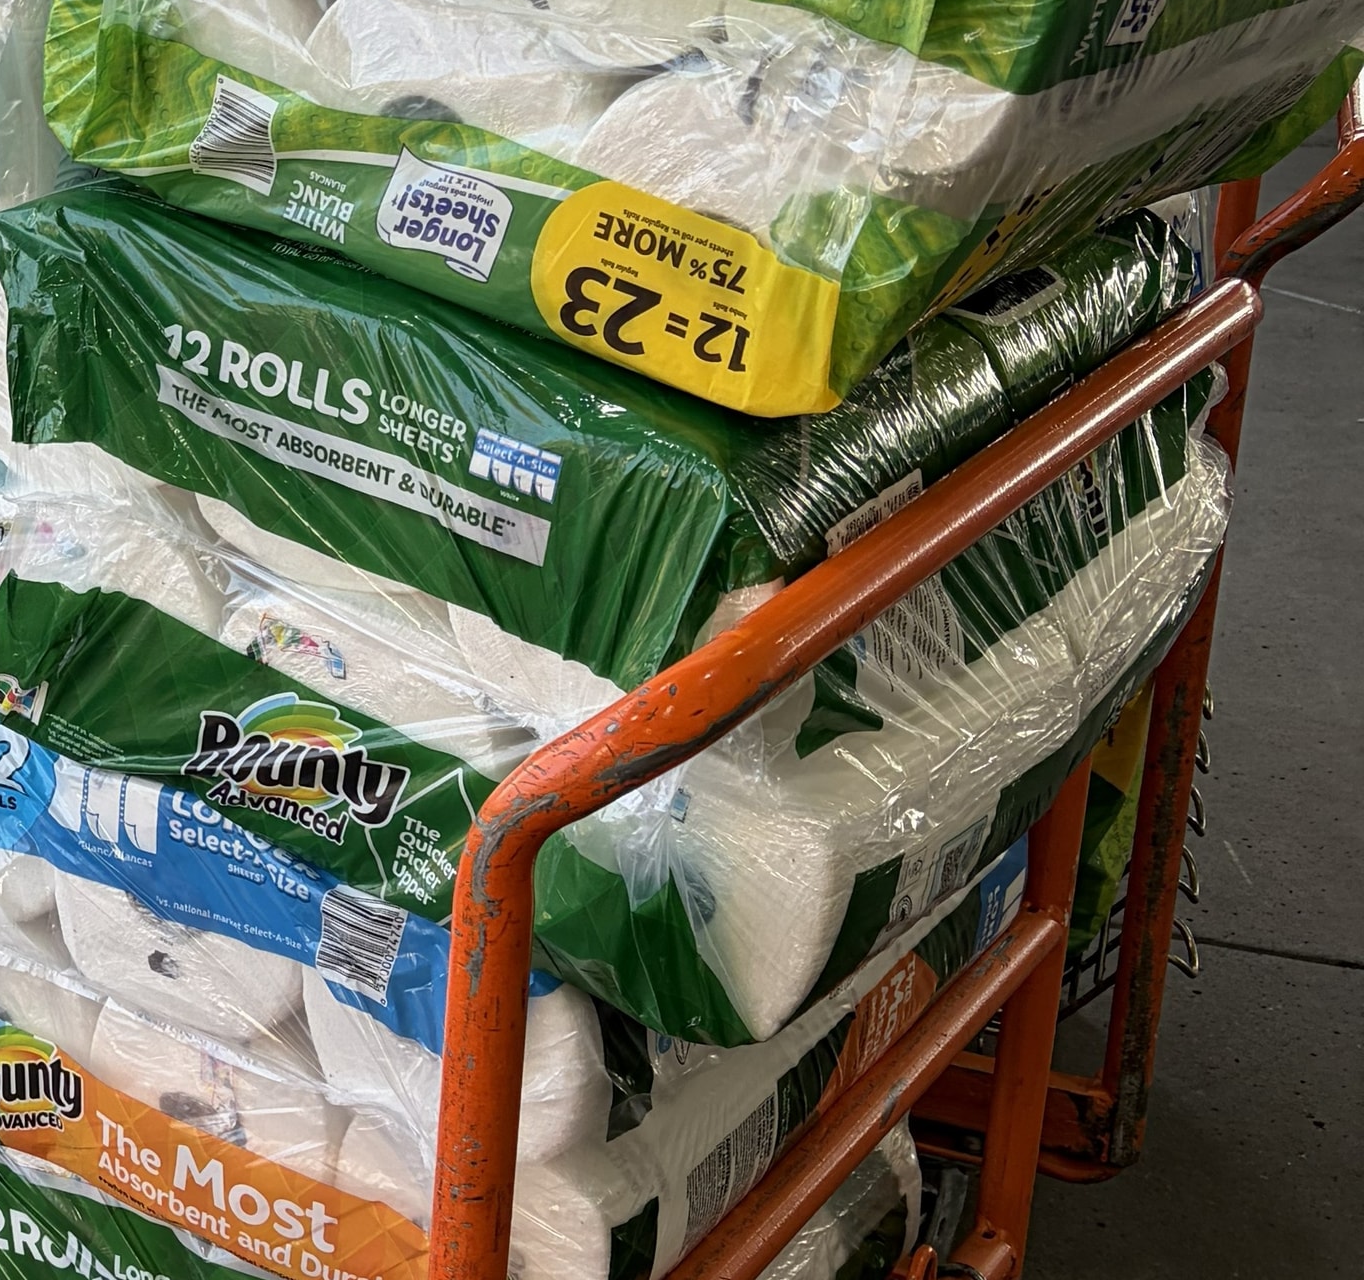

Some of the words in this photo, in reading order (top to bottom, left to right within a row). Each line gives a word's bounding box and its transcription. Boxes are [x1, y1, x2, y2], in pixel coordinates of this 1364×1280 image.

[290, 179, 355, 224] BLANC
[309, 170, 348, 193] BLANCAS
[283, 199, 346, 245] WHITE
[622, 208, 641, 222] Rolls
[641, 216, 670, 235] Regular
[670, 227, 682, 238] vs.
[393, 215, 486, 263] Longer
[593, 211, 687, 269] MORE
[681, 232, 695, 245] roll
[695, 237, 709, 249] per
[709, 243, 735, 258] sheets
[600, 258, 615, 270] Rolls
[615, 261, 639, 278] Regular
[688, 257, 748, 295] 75%
[559, 266, 663, 356] 23
[664, 311, 690, 339] =
[712, 301, 729, 314] Rolls
[693, 311, 751, 373] 12
[164, 323, 212, 377] 12
[218, 338, 373, 425] ROLLS
[378, 389, 468, 443] LONGER
[172, 384, 211, 415] THE
[211, 406, 274, 444] MOST
[276, 431, 395, 486] ABSORBENT
[398, 472, 416, 495] &
[476, 437, 557, 477] Select-A-Size
[500, 489, 520, 502] White
[182, 711, 412, 828] Bounty
[206, 783, 349, 846] Advanced
[403, 815, 442, 842] The
[396, 846, 442, 891] Picker
[398, 832, 457, 883] Quicker
[172, 900, 212, 920] national
[212, 912, 243, 932] market
[243, 923, 303, 952] Select-A-Size
[95, 1109, 162, 1176] The
[172, 1144, 339, 1254] Most
[98, 1151, 232, 1240] Absorbent
[238, 1229, 293, 1269] and
